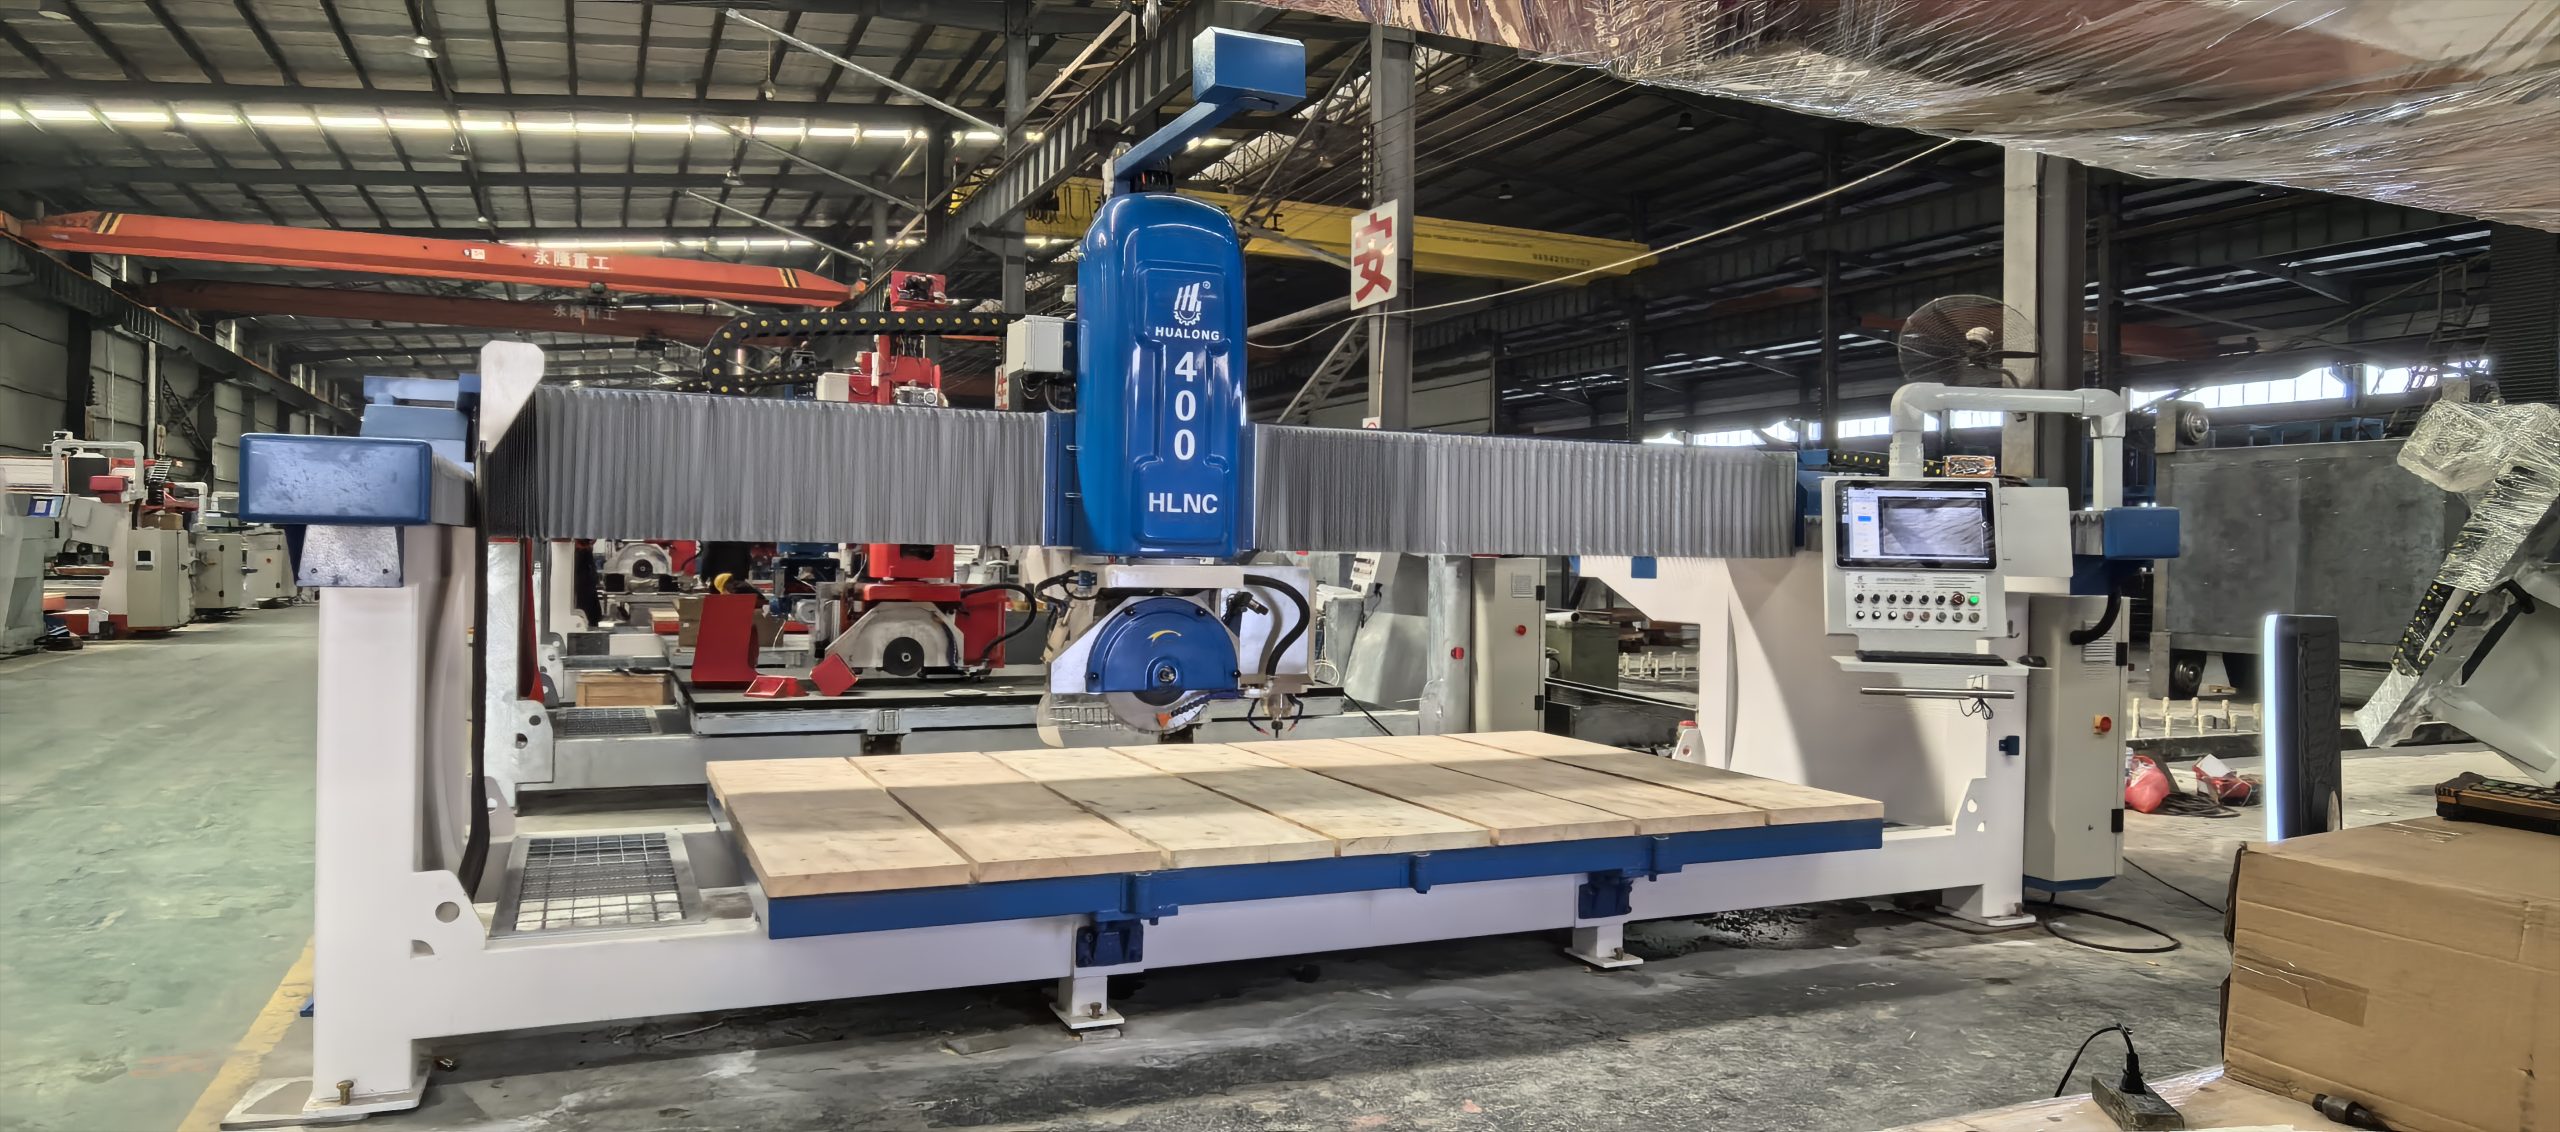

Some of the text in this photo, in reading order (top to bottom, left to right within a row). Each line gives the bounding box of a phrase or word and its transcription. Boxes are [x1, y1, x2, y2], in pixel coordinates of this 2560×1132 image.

[534, 250, 611, 270] 永隆重工
[1354, 212, 1392, 303] 安
[1155, 326, 1220, 341] HUALONG
[1148, 492, 1218, 514] HLNC
